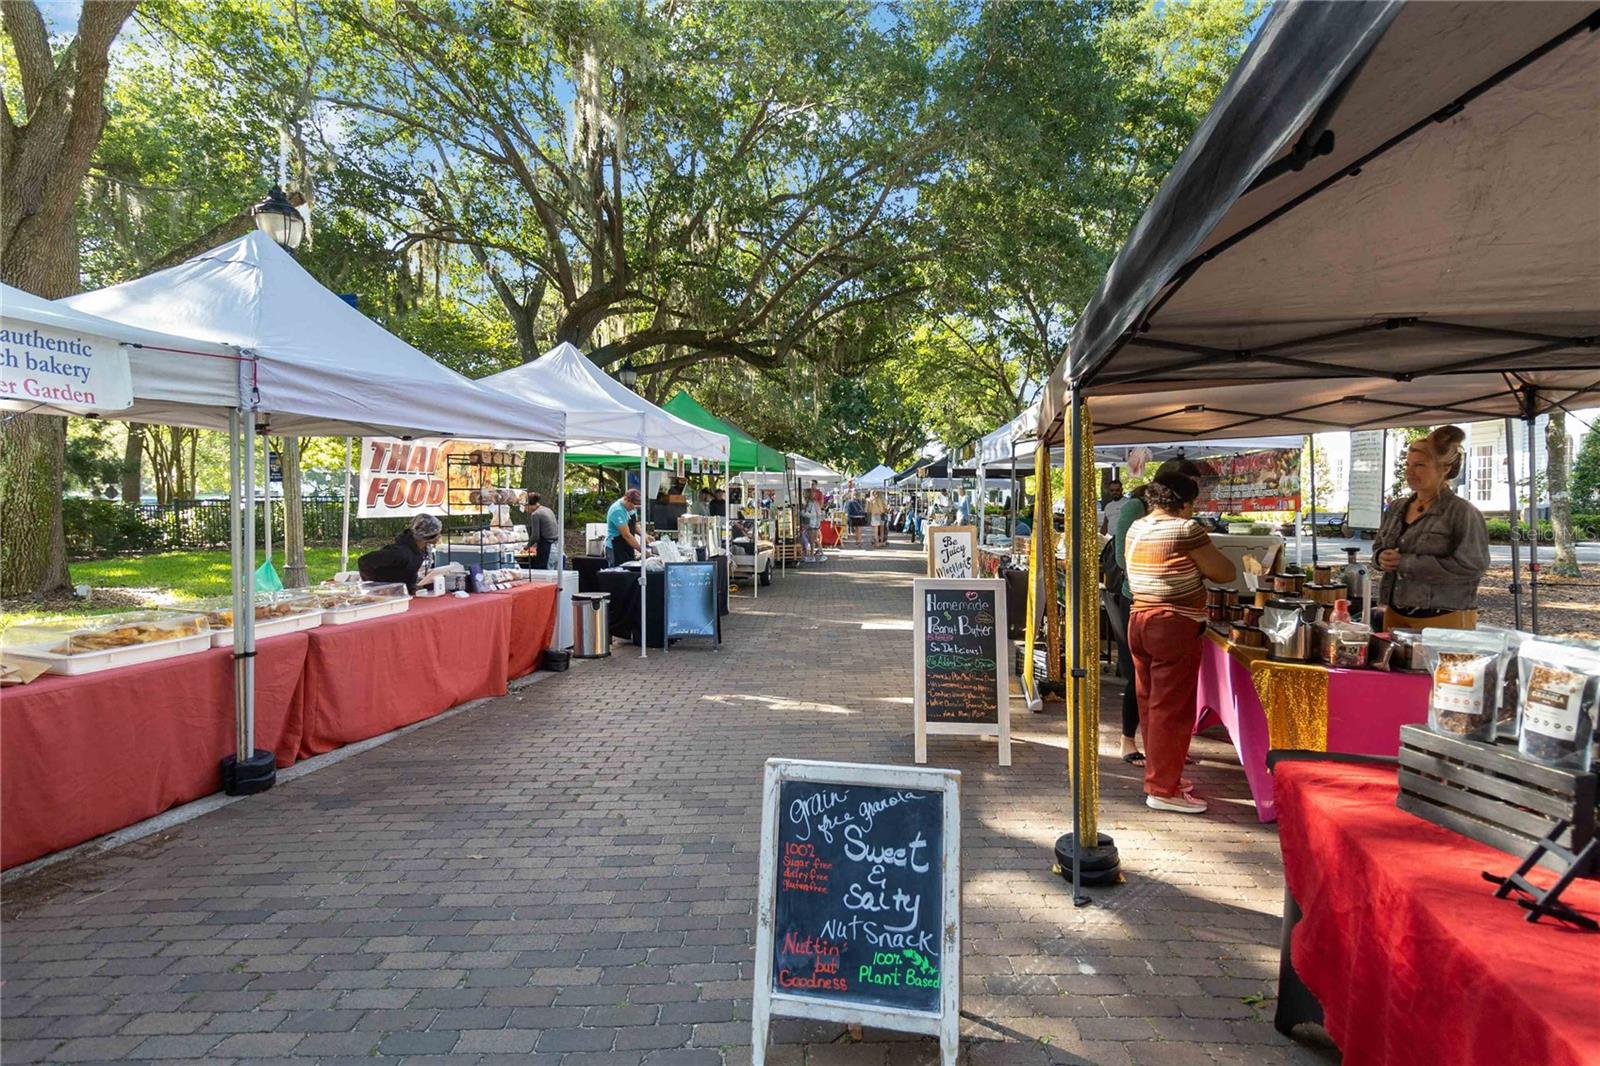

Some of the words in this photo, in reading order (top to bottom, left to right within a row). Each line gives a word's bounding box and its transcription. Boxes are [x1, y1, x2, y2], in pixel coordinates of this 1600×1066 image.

[0, 329, 93, 357] authentic
[25, 351, 91, 383] bakery
[23, 378, 97, 404] Garden
[370, 441, 439, 475] THAI
[366, 477, 446, 508] FOOD
[942, 535, 958, 547] Be
[940, 544, 966, 564] Juicy
[926, 593, 989, 611] Homemade
[958, 614, 993, 638] Butter
[844, 824, 930, 873] Sweet
[820, 915, 864, 941] Nut
[863, 921, 939, 956] Snack
[814, 956, 837, 974] but
[858, 965, 901, 986] Plant
[905, 969, 941, 989] Based
[779, 970, 848, 991] Goodness
